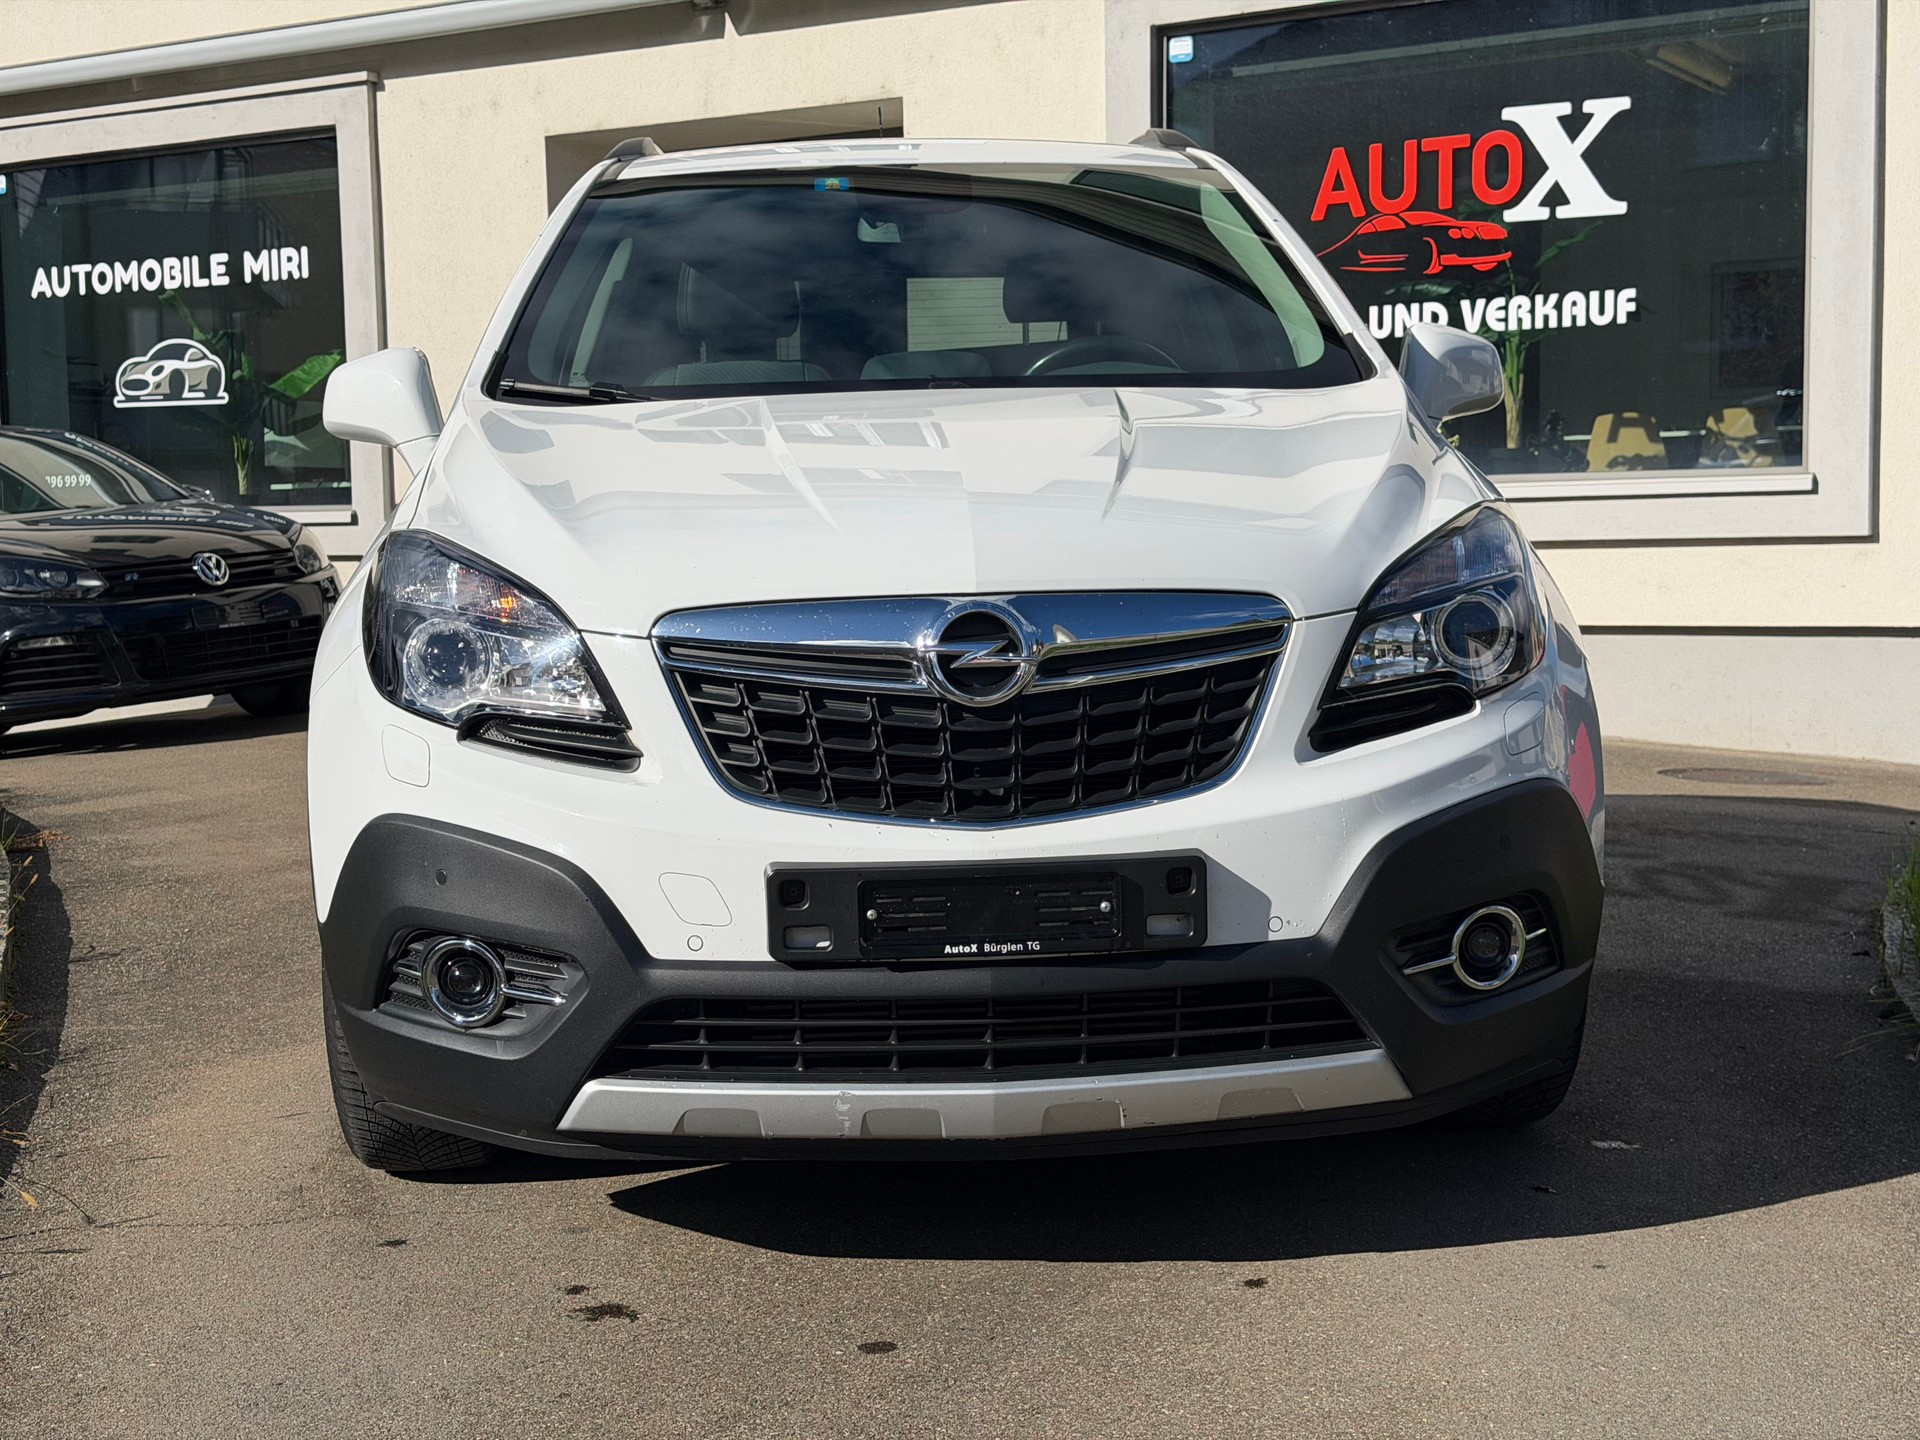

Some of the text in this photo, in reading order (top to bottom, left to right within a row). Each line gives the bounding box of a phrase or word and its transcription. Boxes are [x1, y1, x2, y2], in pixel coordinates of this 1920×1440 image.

[31, 245, 309, 300] AUTOMOBILE MIRI
[1368, 287, 1637, 340] UND VERKAUF
[64, 474, 77, 488] 99
[78, 473, 92, 487] 99
[944, 941, 1041, 954] AutoX Bürglen TG
